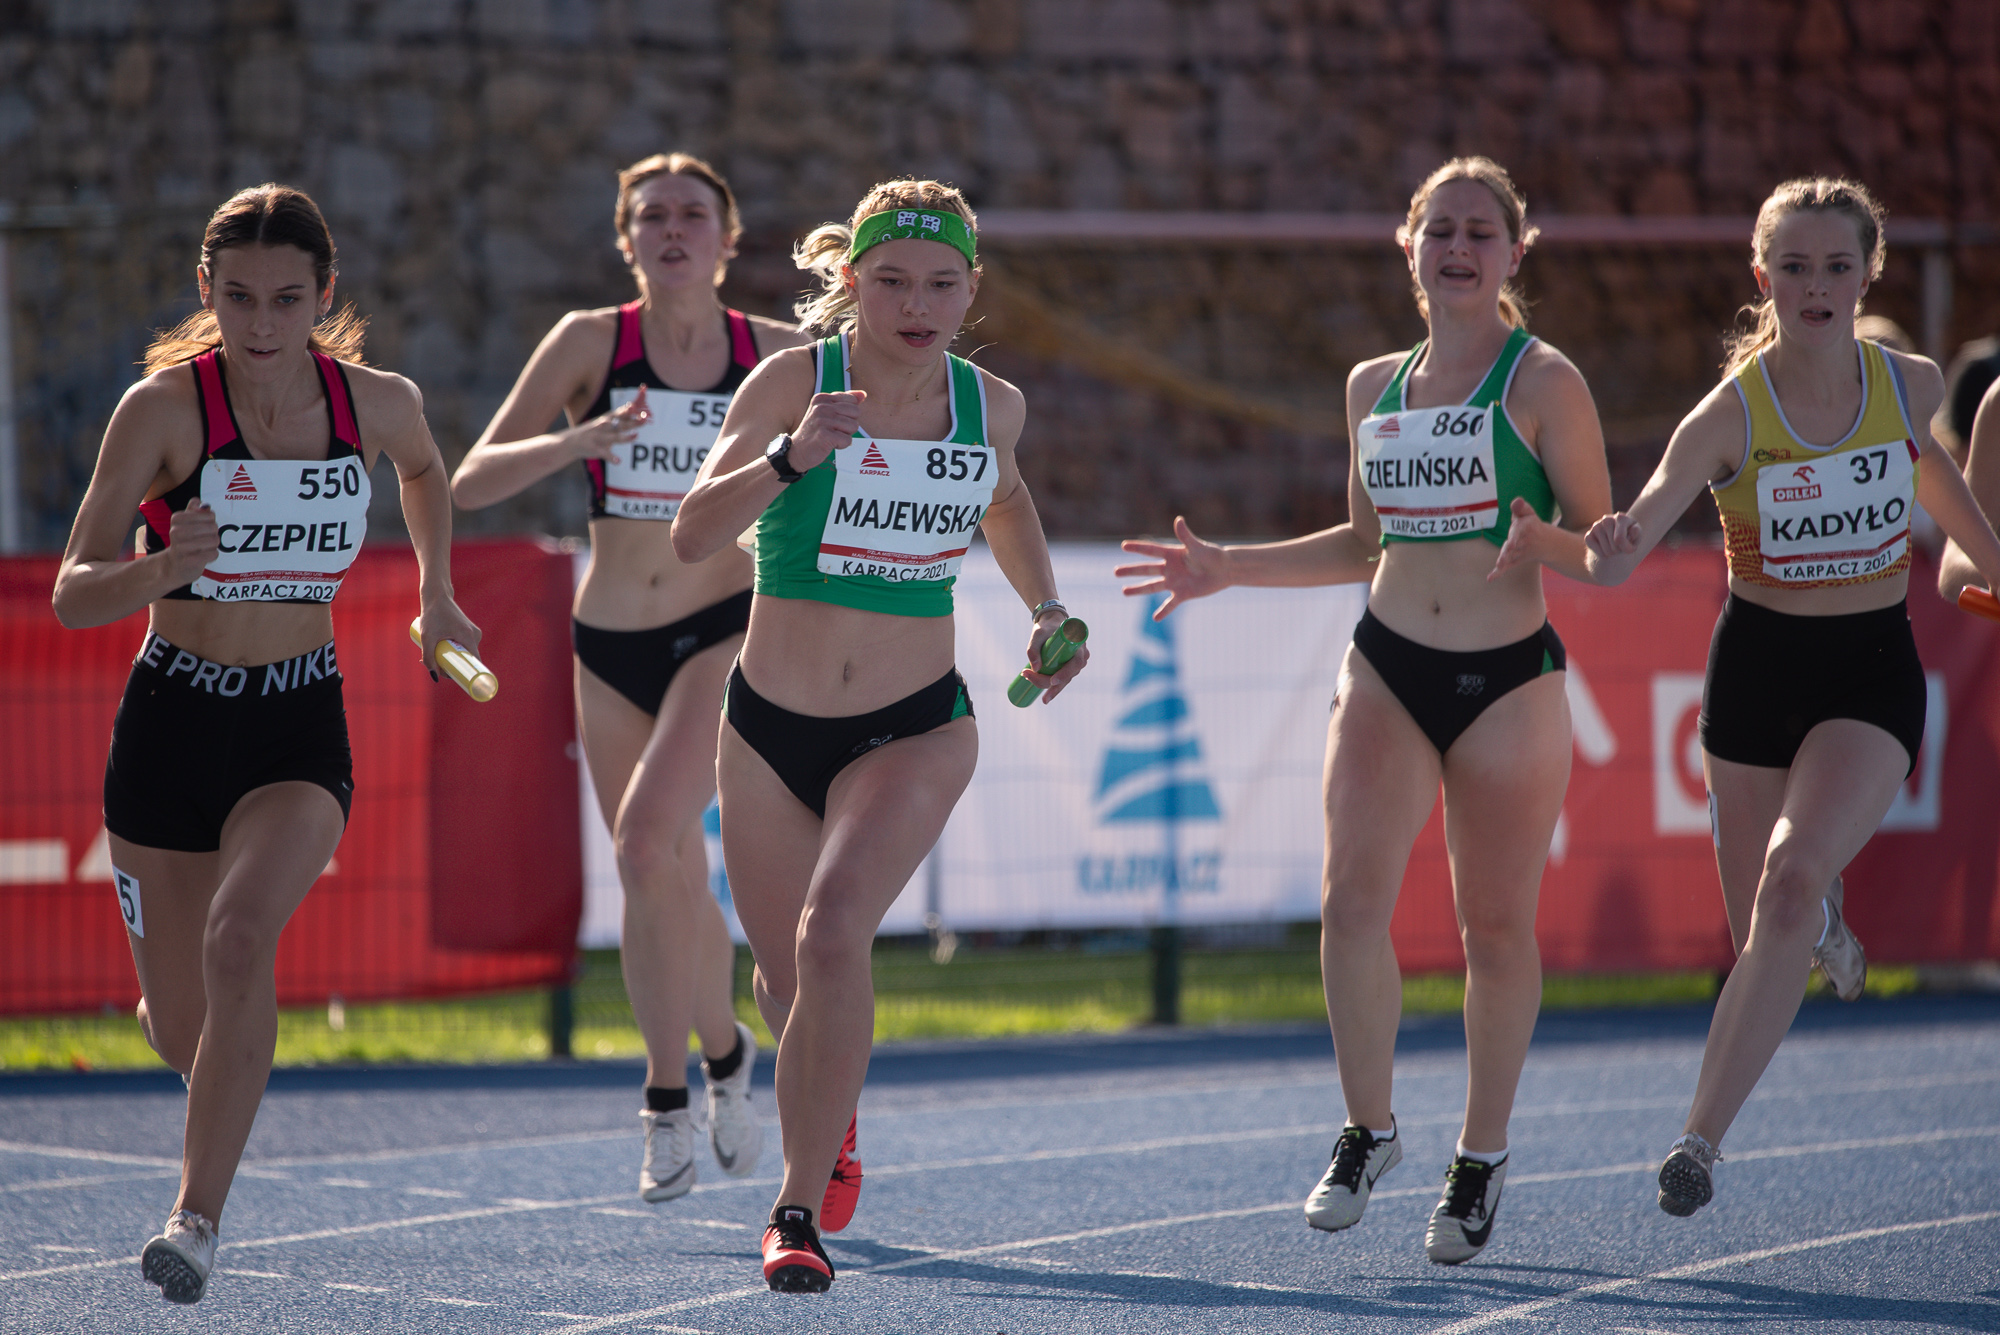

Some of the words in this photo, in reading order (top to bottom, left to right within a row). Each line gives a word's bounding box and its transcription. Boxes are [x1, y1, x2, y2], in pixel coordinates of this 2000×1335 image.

[689, 400, 725, 427] 55
[297, 464, 359, 500] 550
[926, 448, 988, 482] 857
[1366, 451, 1488, 489] ZIELIŃSKA
[1850, 450, 1888, 484] 37
[1775, 486, 1820, 501] ORLEN
[834, 497, 982, 535] MAJEWSKA
[1391, 520, 1438, 535] KARPACZ
[1441, 515, 1475, 533] 2021
[1772, 497, 1905, 542] KADYŁO
[217, 521, 352, 553] CZEPIEL
[842, 560, 919, 580] KARPACZ
[921, 562, 948, 580] 2021
[1783, 562, 1859, 579] KARPACZ
[1864, 550, 1892, 572] 2021
[216, 584, 298, 599] KARPACZ
[166, 649, 247, 697] PRO
[261, 639, 338, 696] NIKE
[118, 873, 135, 926] 5
